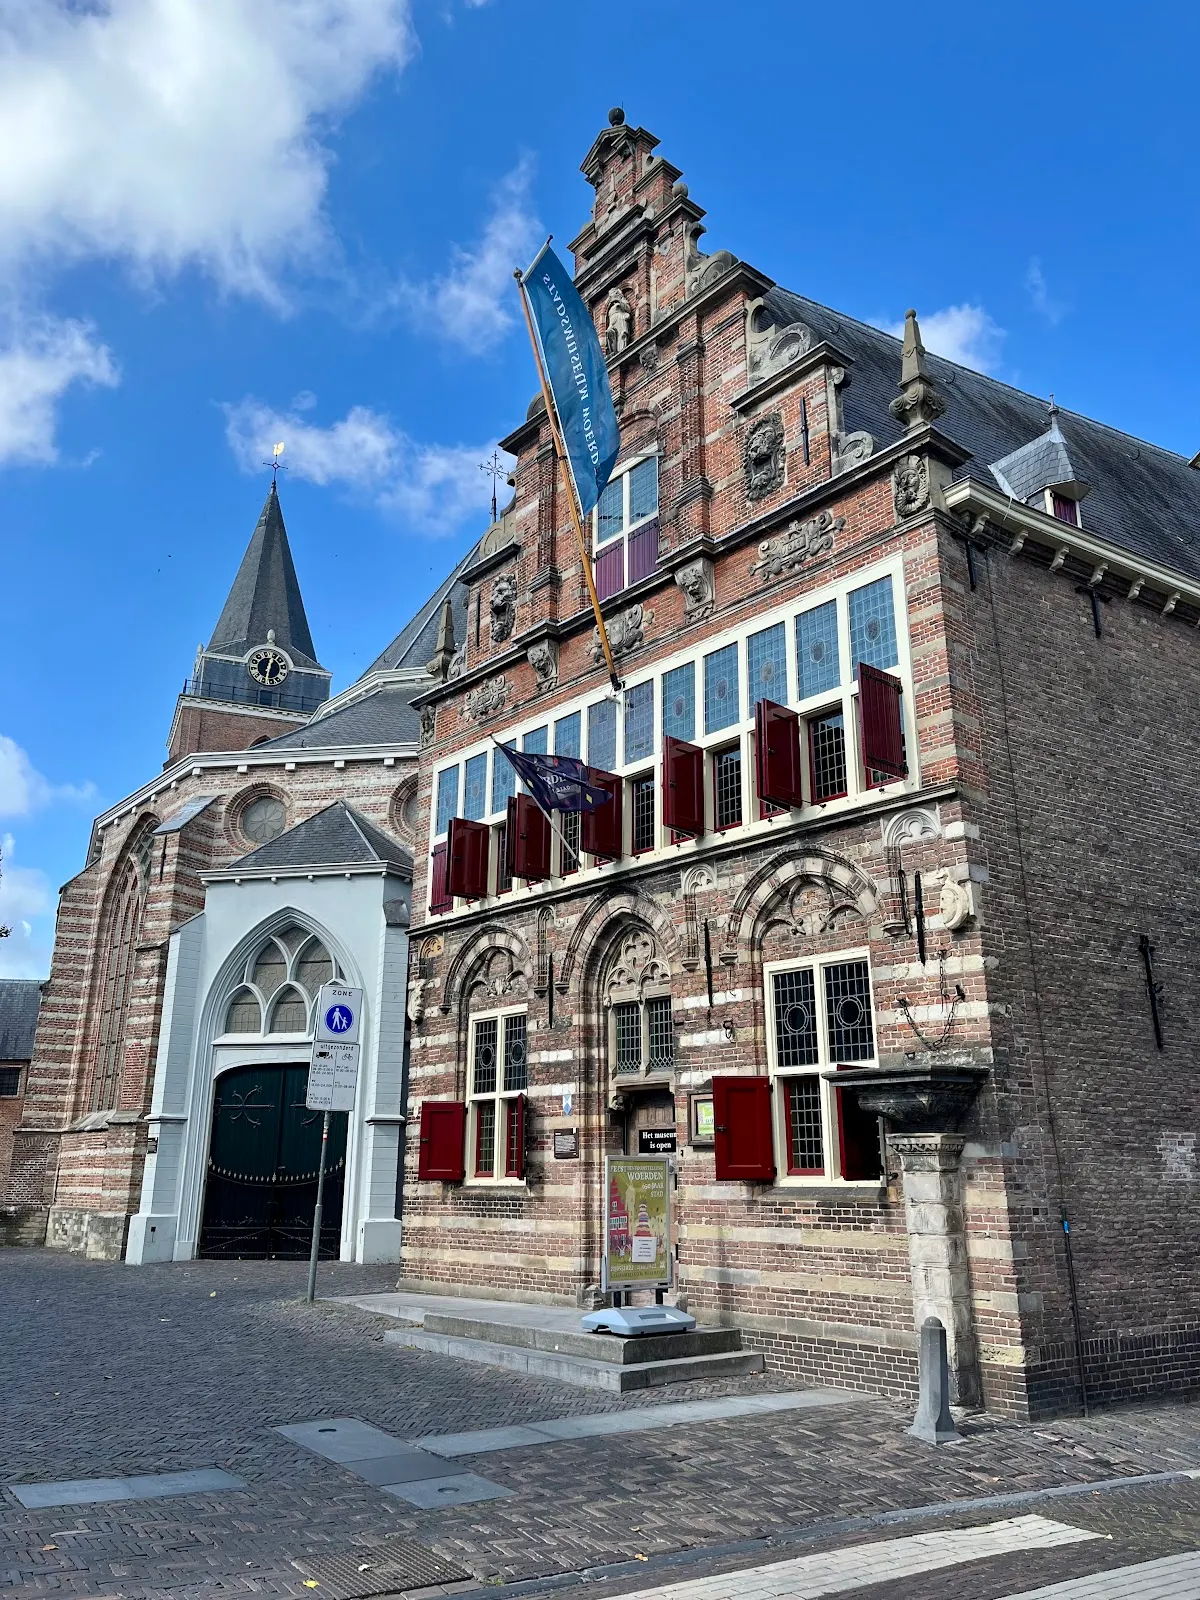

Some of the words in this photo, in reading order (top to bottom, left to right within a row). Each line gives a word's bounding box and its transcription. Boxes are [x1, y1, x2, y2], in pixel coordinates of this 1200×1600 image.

[332, 989, 353, 997] ZONE
[642, 1131, 653, 1139] Het
[656, 1142, 672, 1151] open
[627, 1171, 663, 1180] WOERDEN
